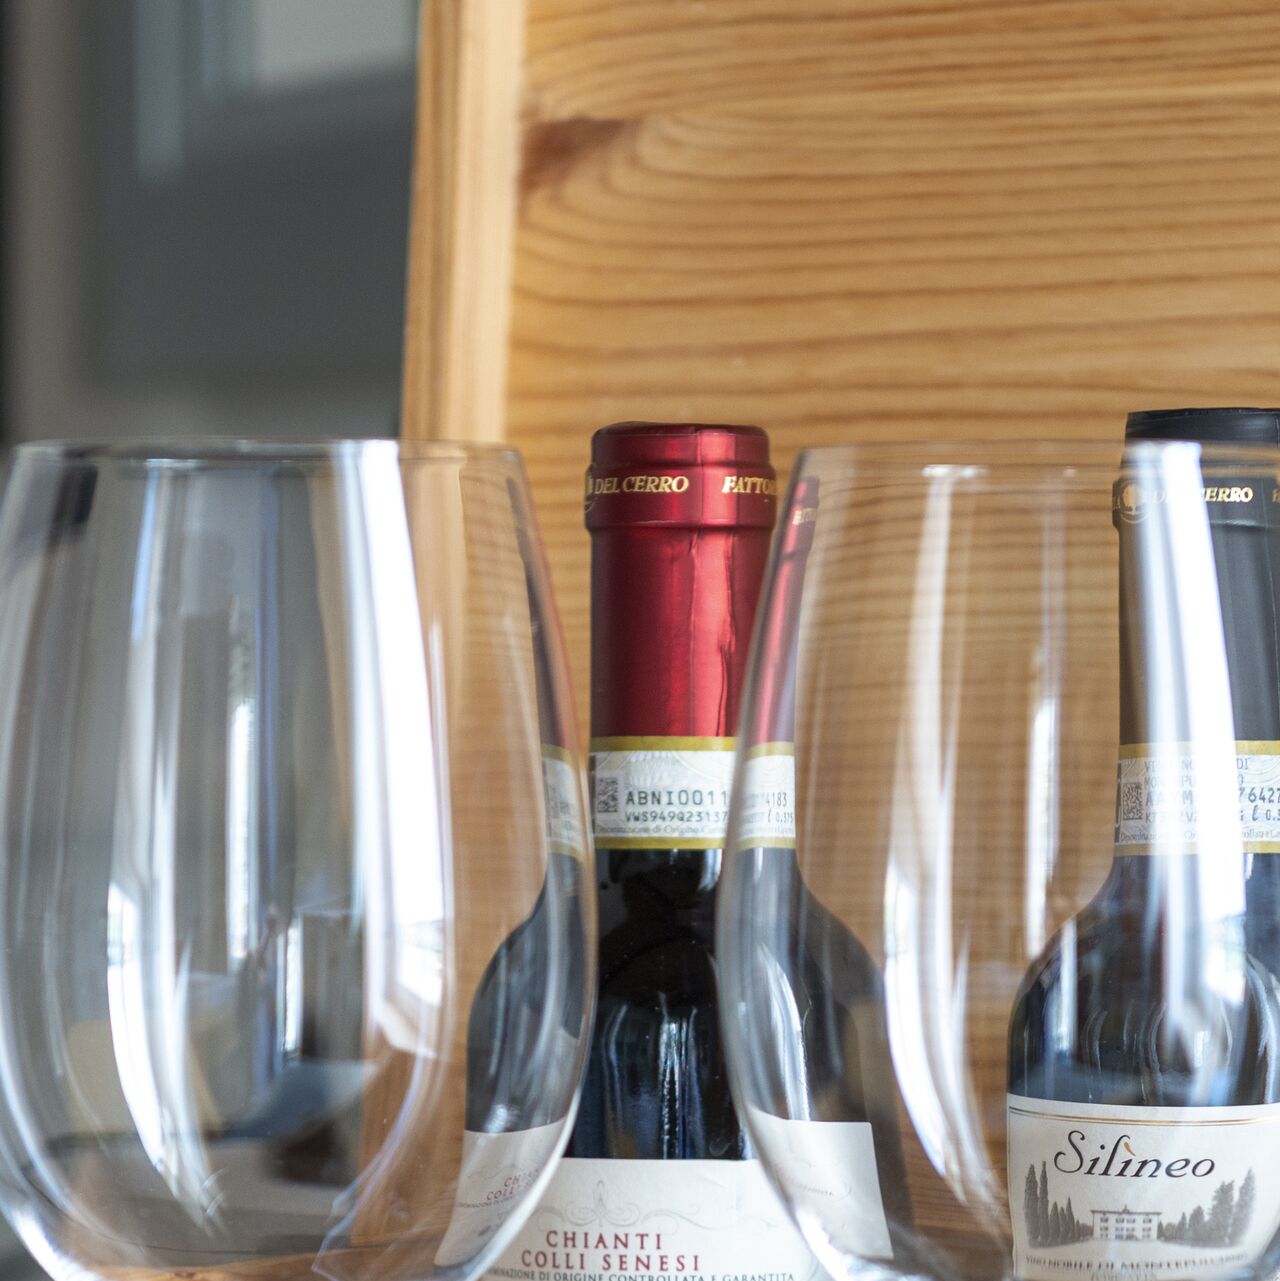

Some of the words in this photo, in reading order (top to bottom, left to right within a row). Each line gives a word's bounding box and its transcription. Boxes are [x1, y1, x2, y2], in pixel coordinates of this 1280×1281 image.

[595, 476, 619, 494] DEL
[623, 475, 690, 493] CERRO
[546, 1230, 663, 1250] CHIANTI
[521, 1250, 587, 1270] COLLI
[602, 1254, 701, 1272] SENESI
[539, 1271, 550, 1281] DI
